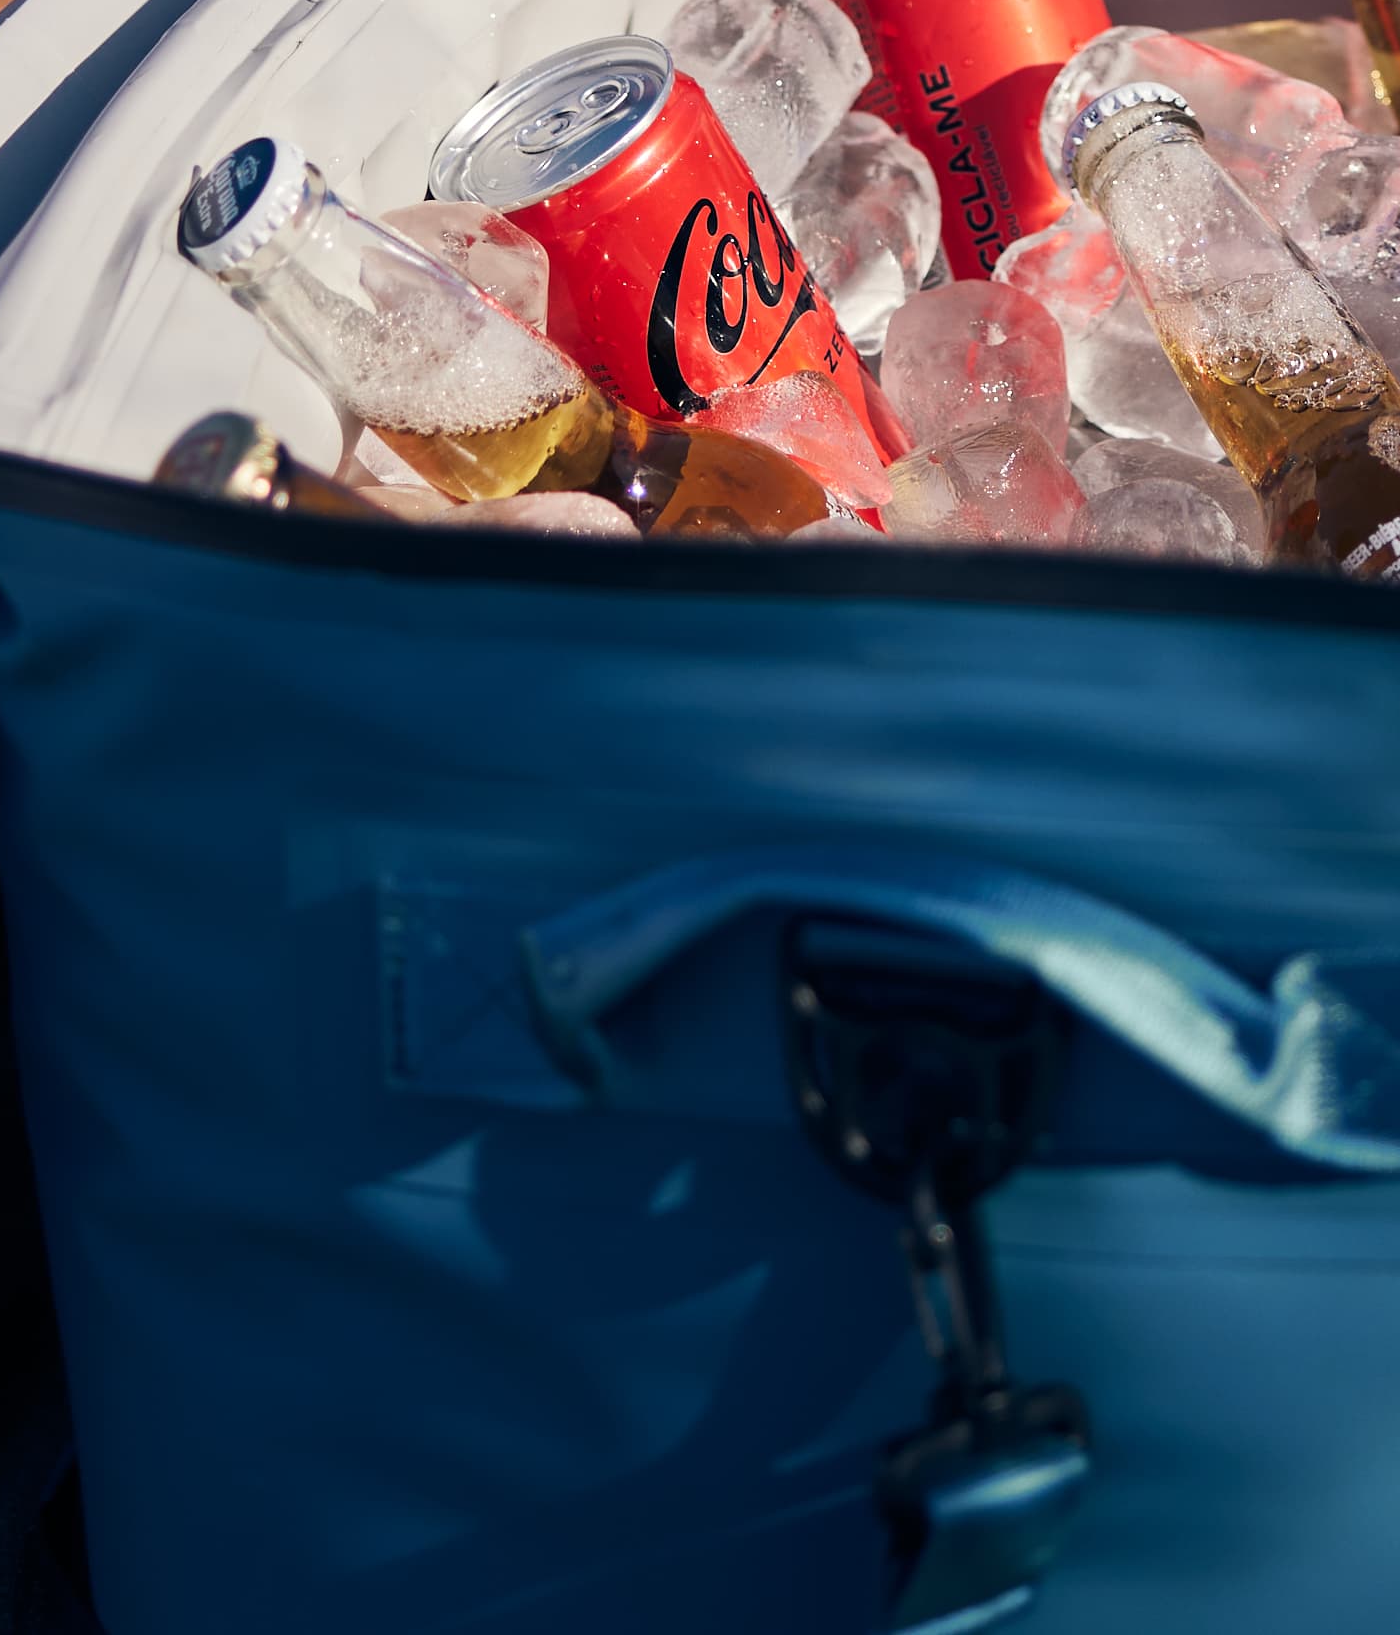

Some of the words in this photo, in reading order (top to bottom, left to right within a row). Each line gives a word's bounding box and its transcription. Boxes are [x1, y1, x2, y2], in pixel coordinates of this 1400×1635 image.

[208, 154, 239, 227] Corona
[919, 64, 1005, 280] CICLA-ME
[197, 185, 213, 233] Extra
